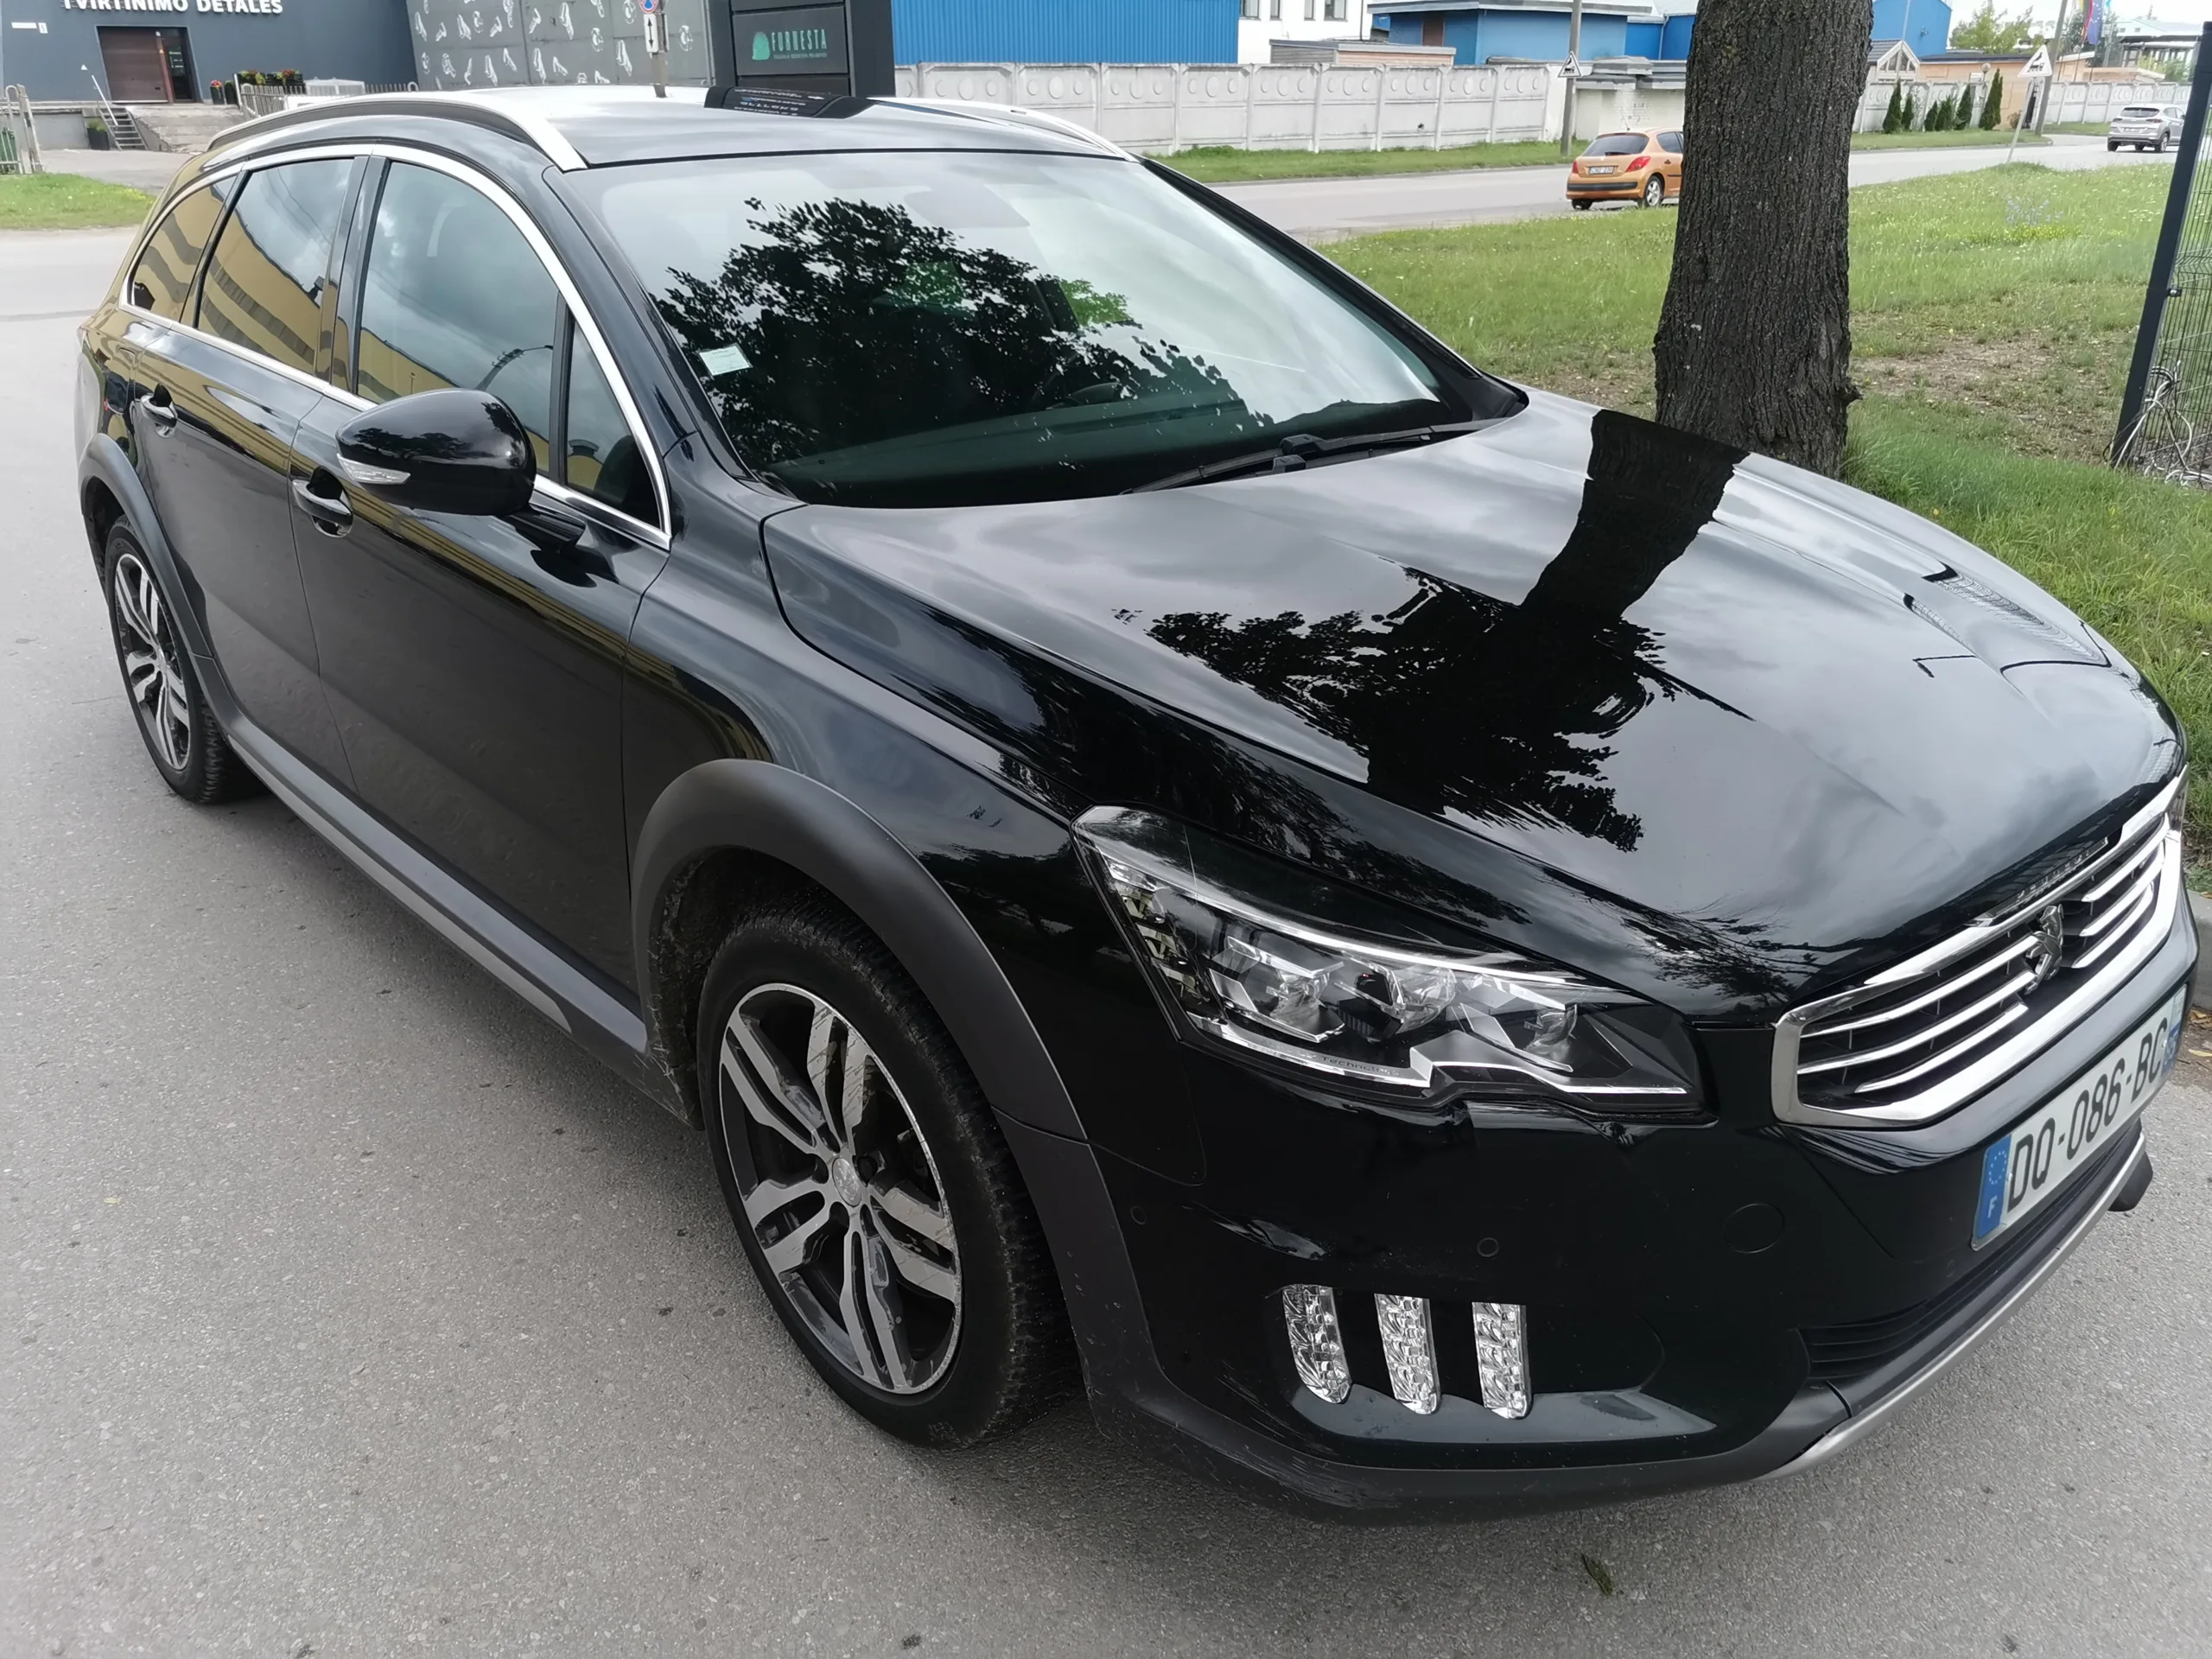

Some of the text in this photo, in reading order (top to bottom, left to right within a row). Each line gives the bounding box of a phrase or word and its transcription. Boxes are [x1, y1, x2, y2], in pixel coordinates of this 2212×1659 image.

[196, 0, 283, 14] DETALES
[2007, 1017, 2167, 1213] DQ-086-BC
[1987, 1194, 1999, 1219] F
